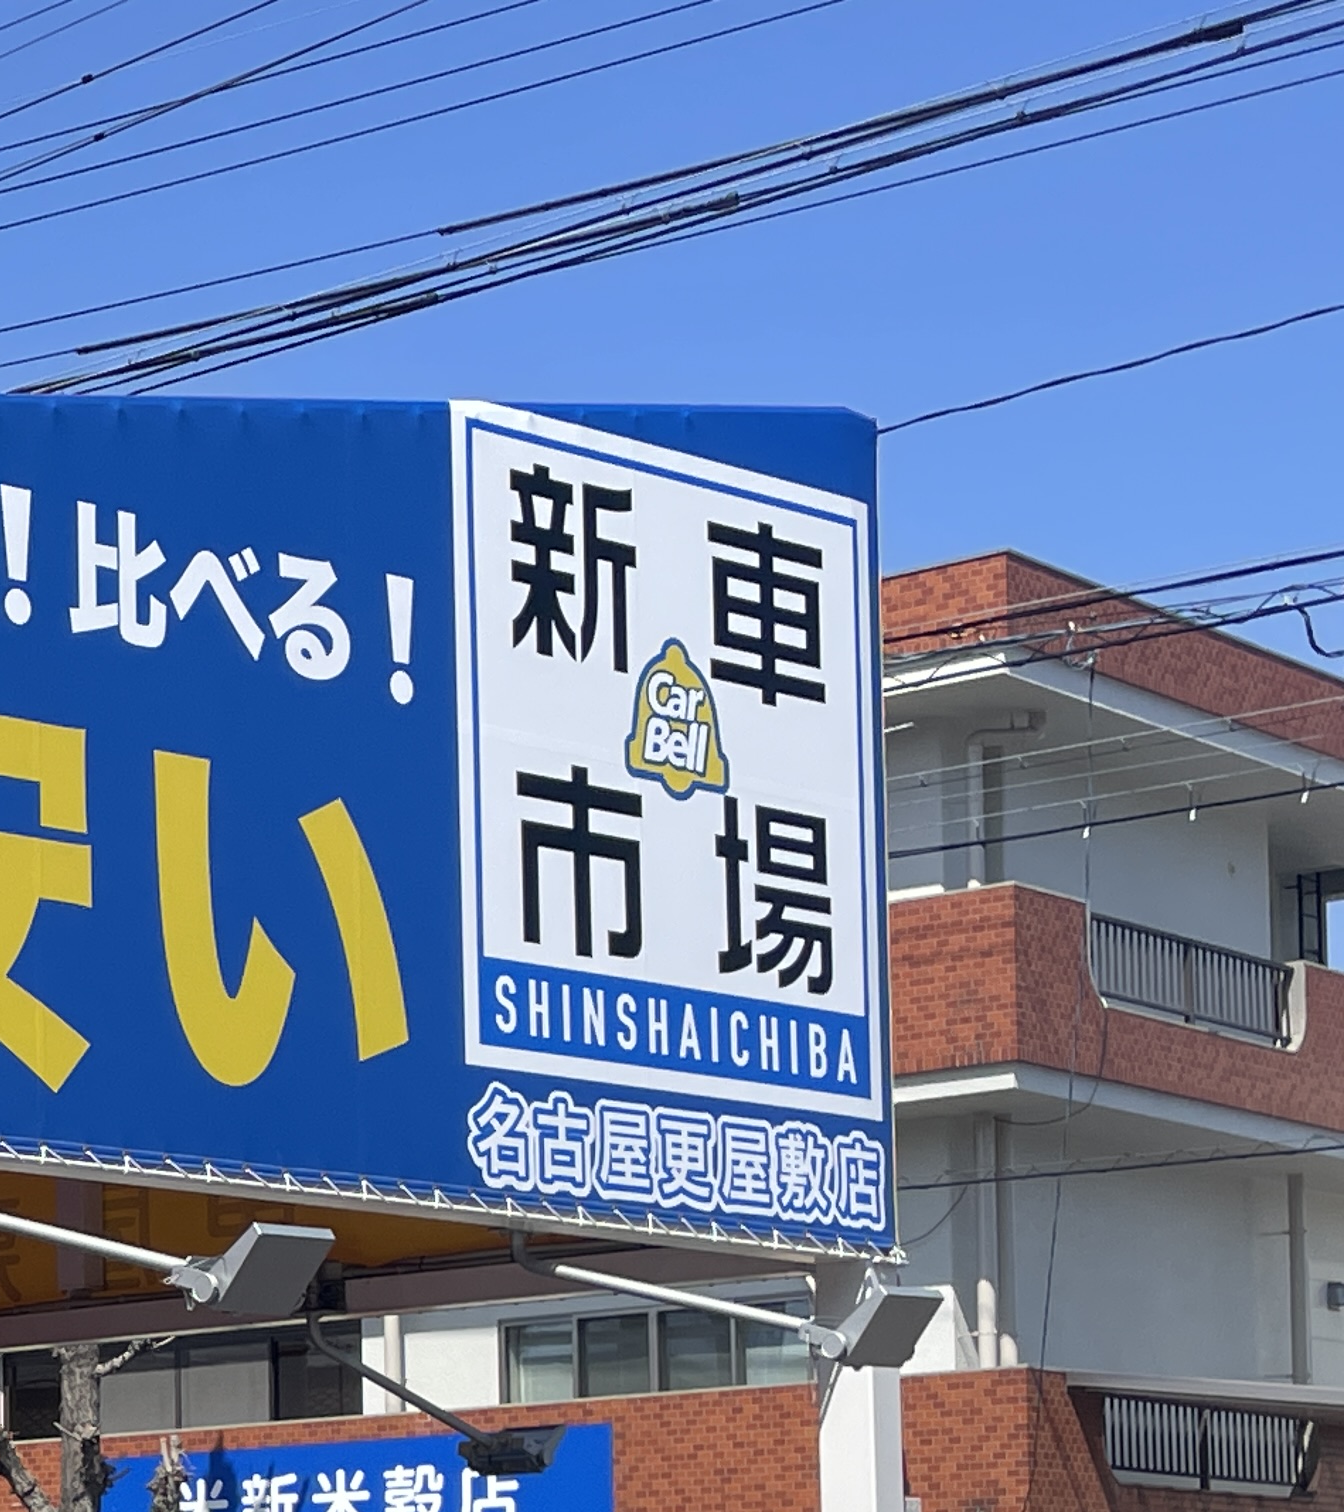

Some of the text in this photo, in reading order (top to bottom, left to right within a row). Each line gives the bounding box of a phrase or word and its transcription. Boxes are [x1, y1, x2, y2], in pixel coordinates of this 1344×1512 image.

[509, 462, 827, 707] 新車
[644, 717, 709, 775] Bell
[647, 670, 705, 722] Car
[516, 764, 834, 996] 市場
[494, 974, 858, 1085] SHINSHAICHIBA
[468, 1081, 886, 1231] 名古屋更屋敷店
